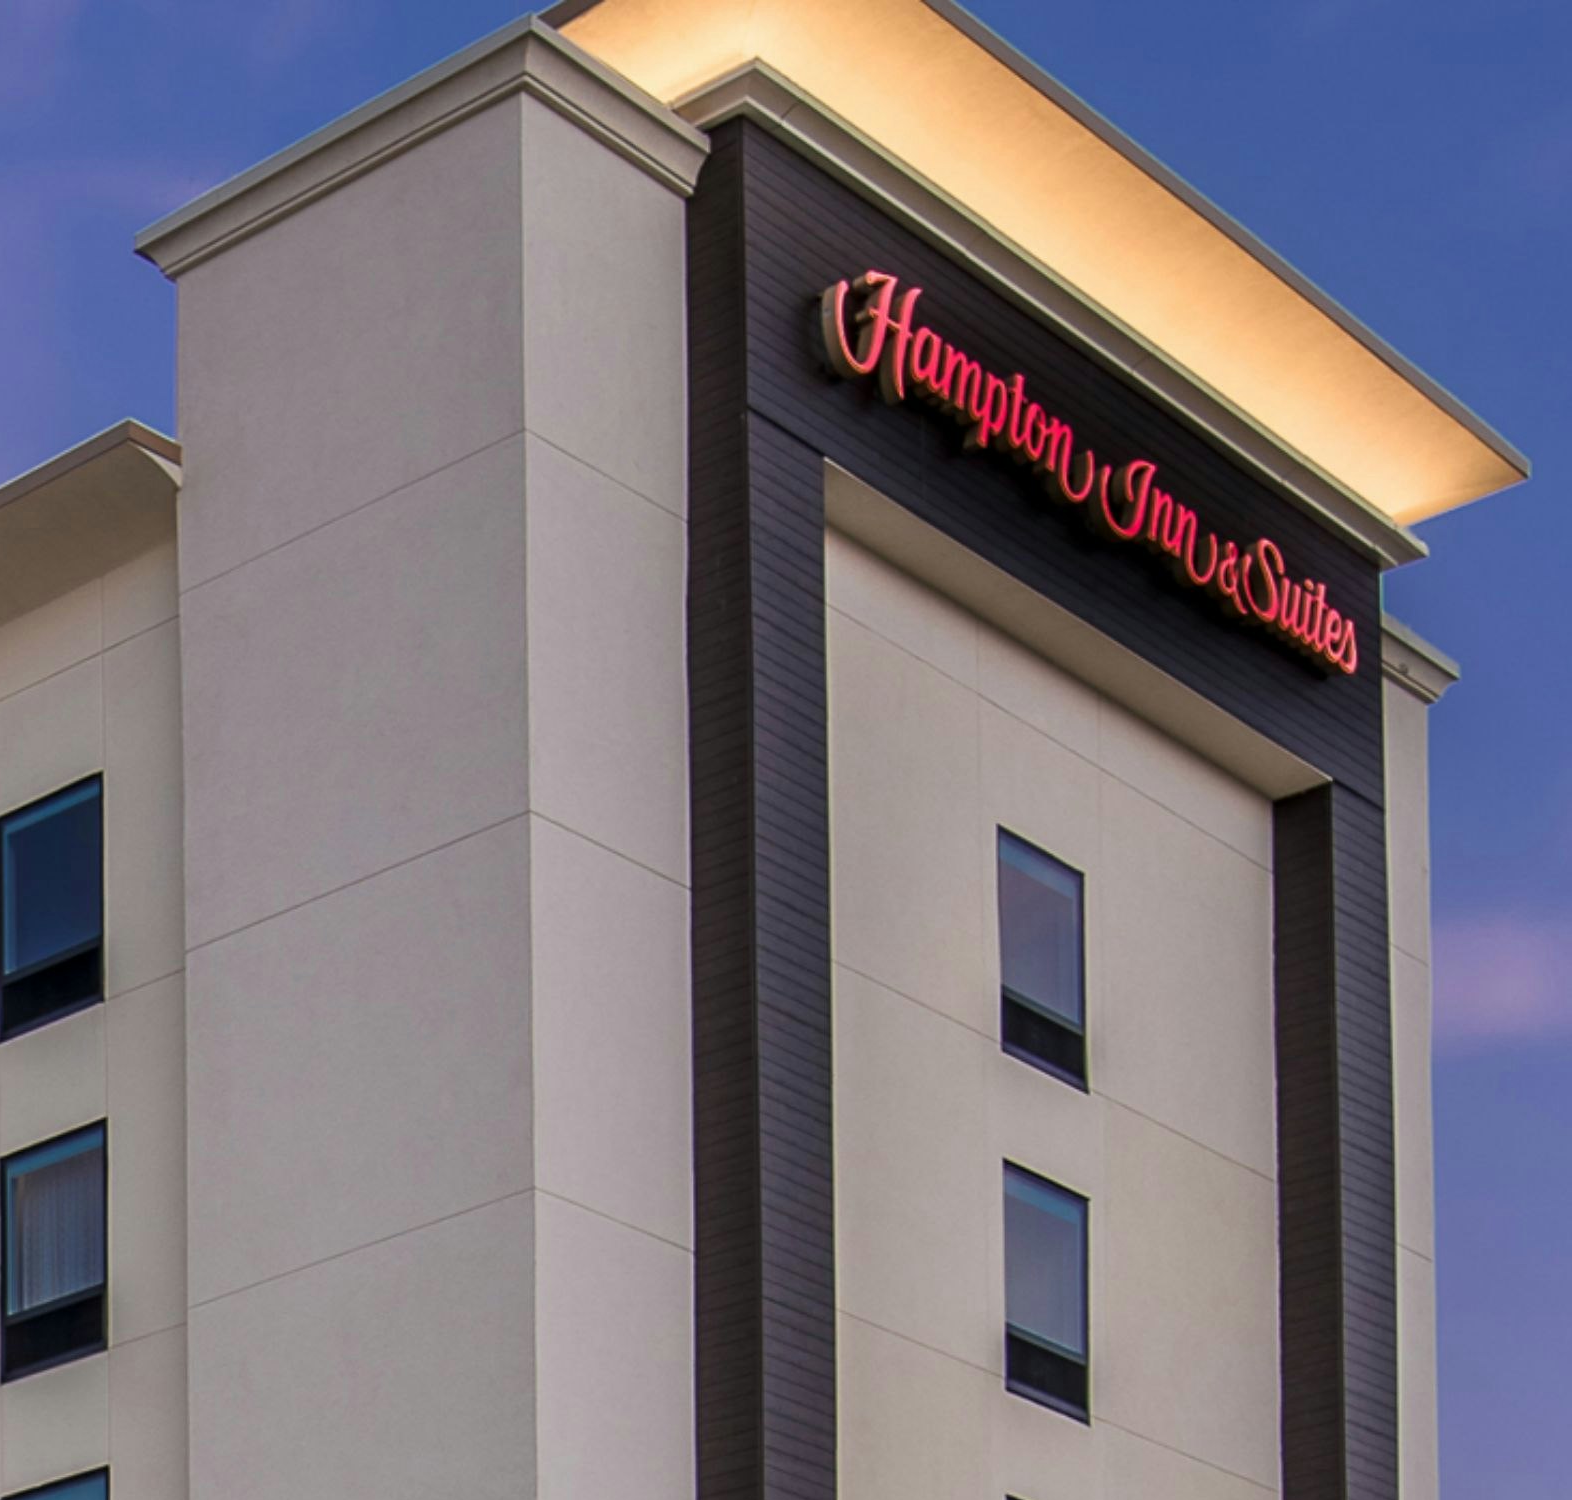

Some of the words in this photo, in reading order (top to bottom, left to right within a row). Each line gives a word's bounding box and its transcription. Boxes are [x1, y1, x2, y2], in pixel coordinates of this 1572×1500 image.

[832, 268, 1096, 502] Hampton
[1099, 458, 1219, 585] Inn
[1217, 540, 1248, 614] &
[1241, 537, 1358, 675] Suites
